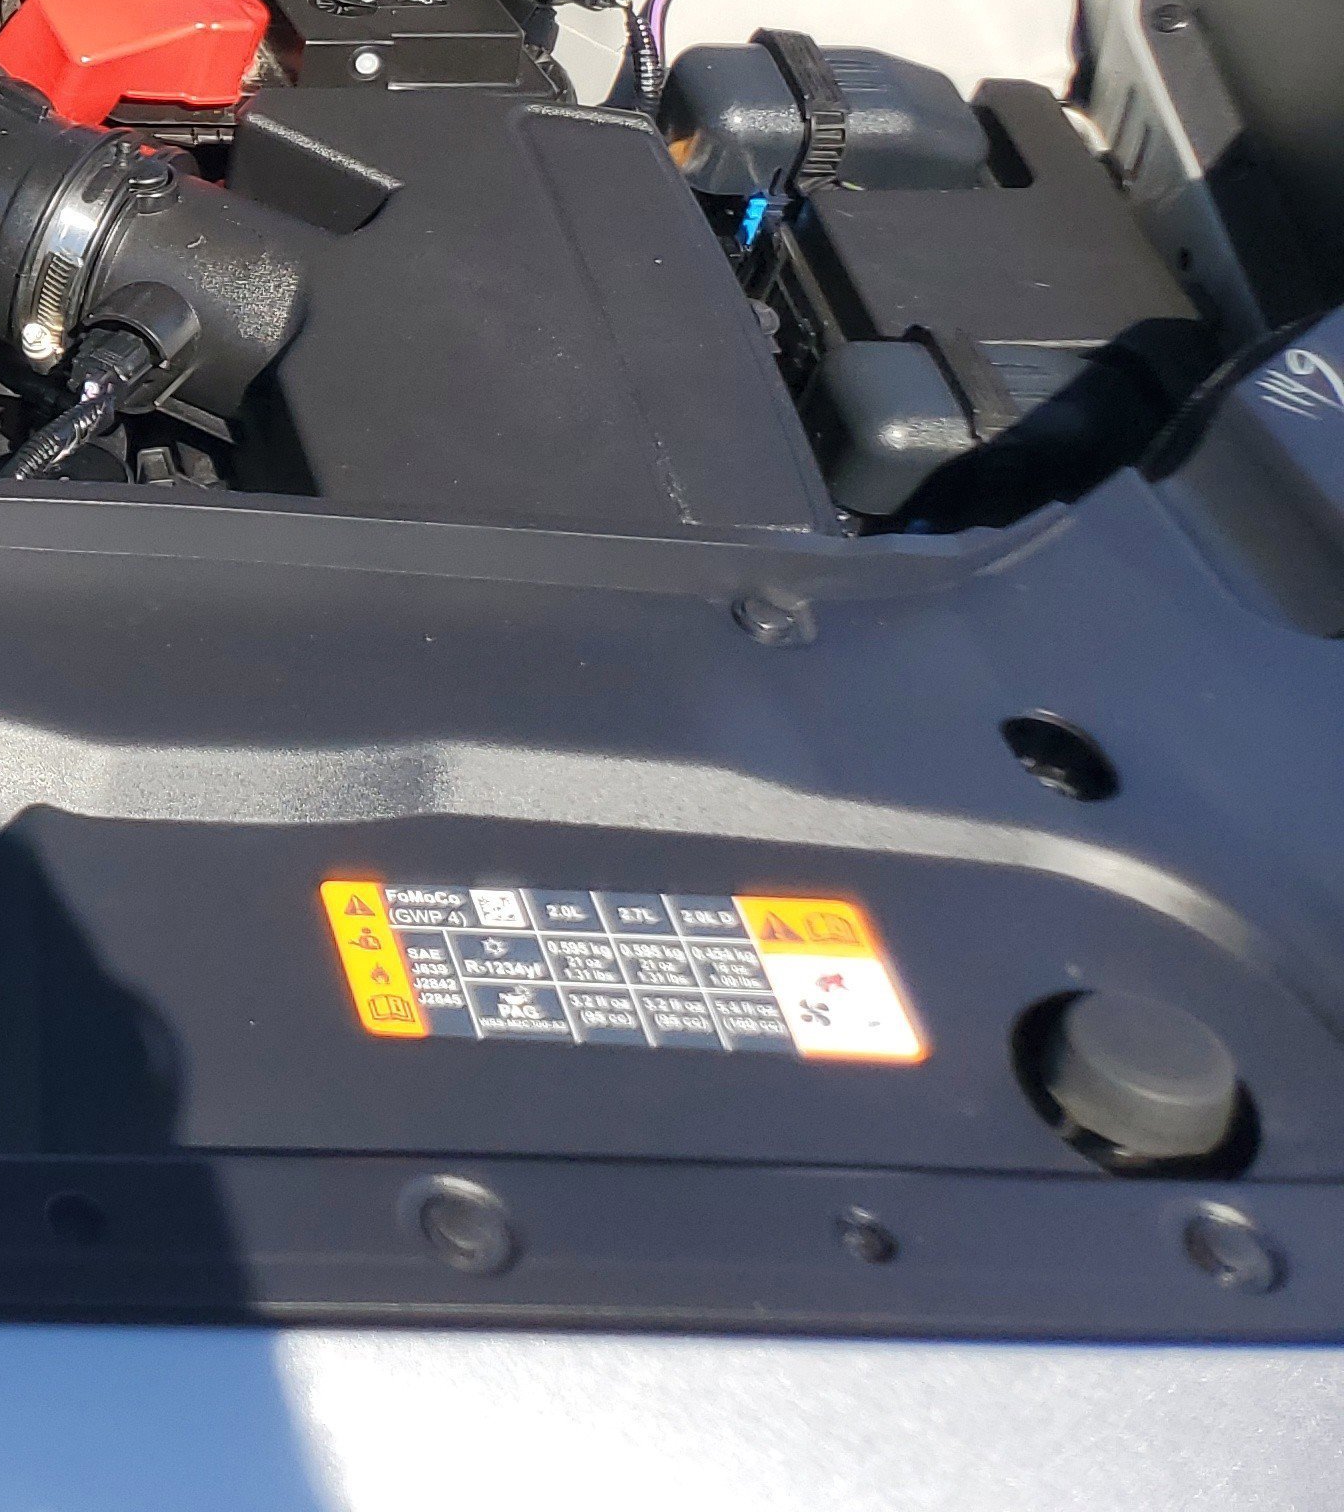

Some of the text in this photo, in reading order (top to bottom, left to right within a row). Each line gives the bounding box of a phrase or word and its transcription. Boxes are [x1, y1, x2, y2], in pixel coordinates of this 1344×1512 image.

[385, 888, 462, 905] FoMoCo
[388, 908, 467, 927] (GWP 4)
[546, 904, 587, 922] 2.0L
[617, 907, 660, 925] 2.7L
[407, 947, 442, 960] SAE
[590, 941, 613, 960] kg
[662, 945, 687, 963] kg
[412, 962, 449, 975] J639
[464, 959, 543, 979] R-1234yf
[566, 955, 584, 968] 21
[638, 958, 657, 972] 21
[414, 977, 457, 990] J2842
[418, 992, 462, 1005] J2845
[497, 1003, 541, 1020] PAG
